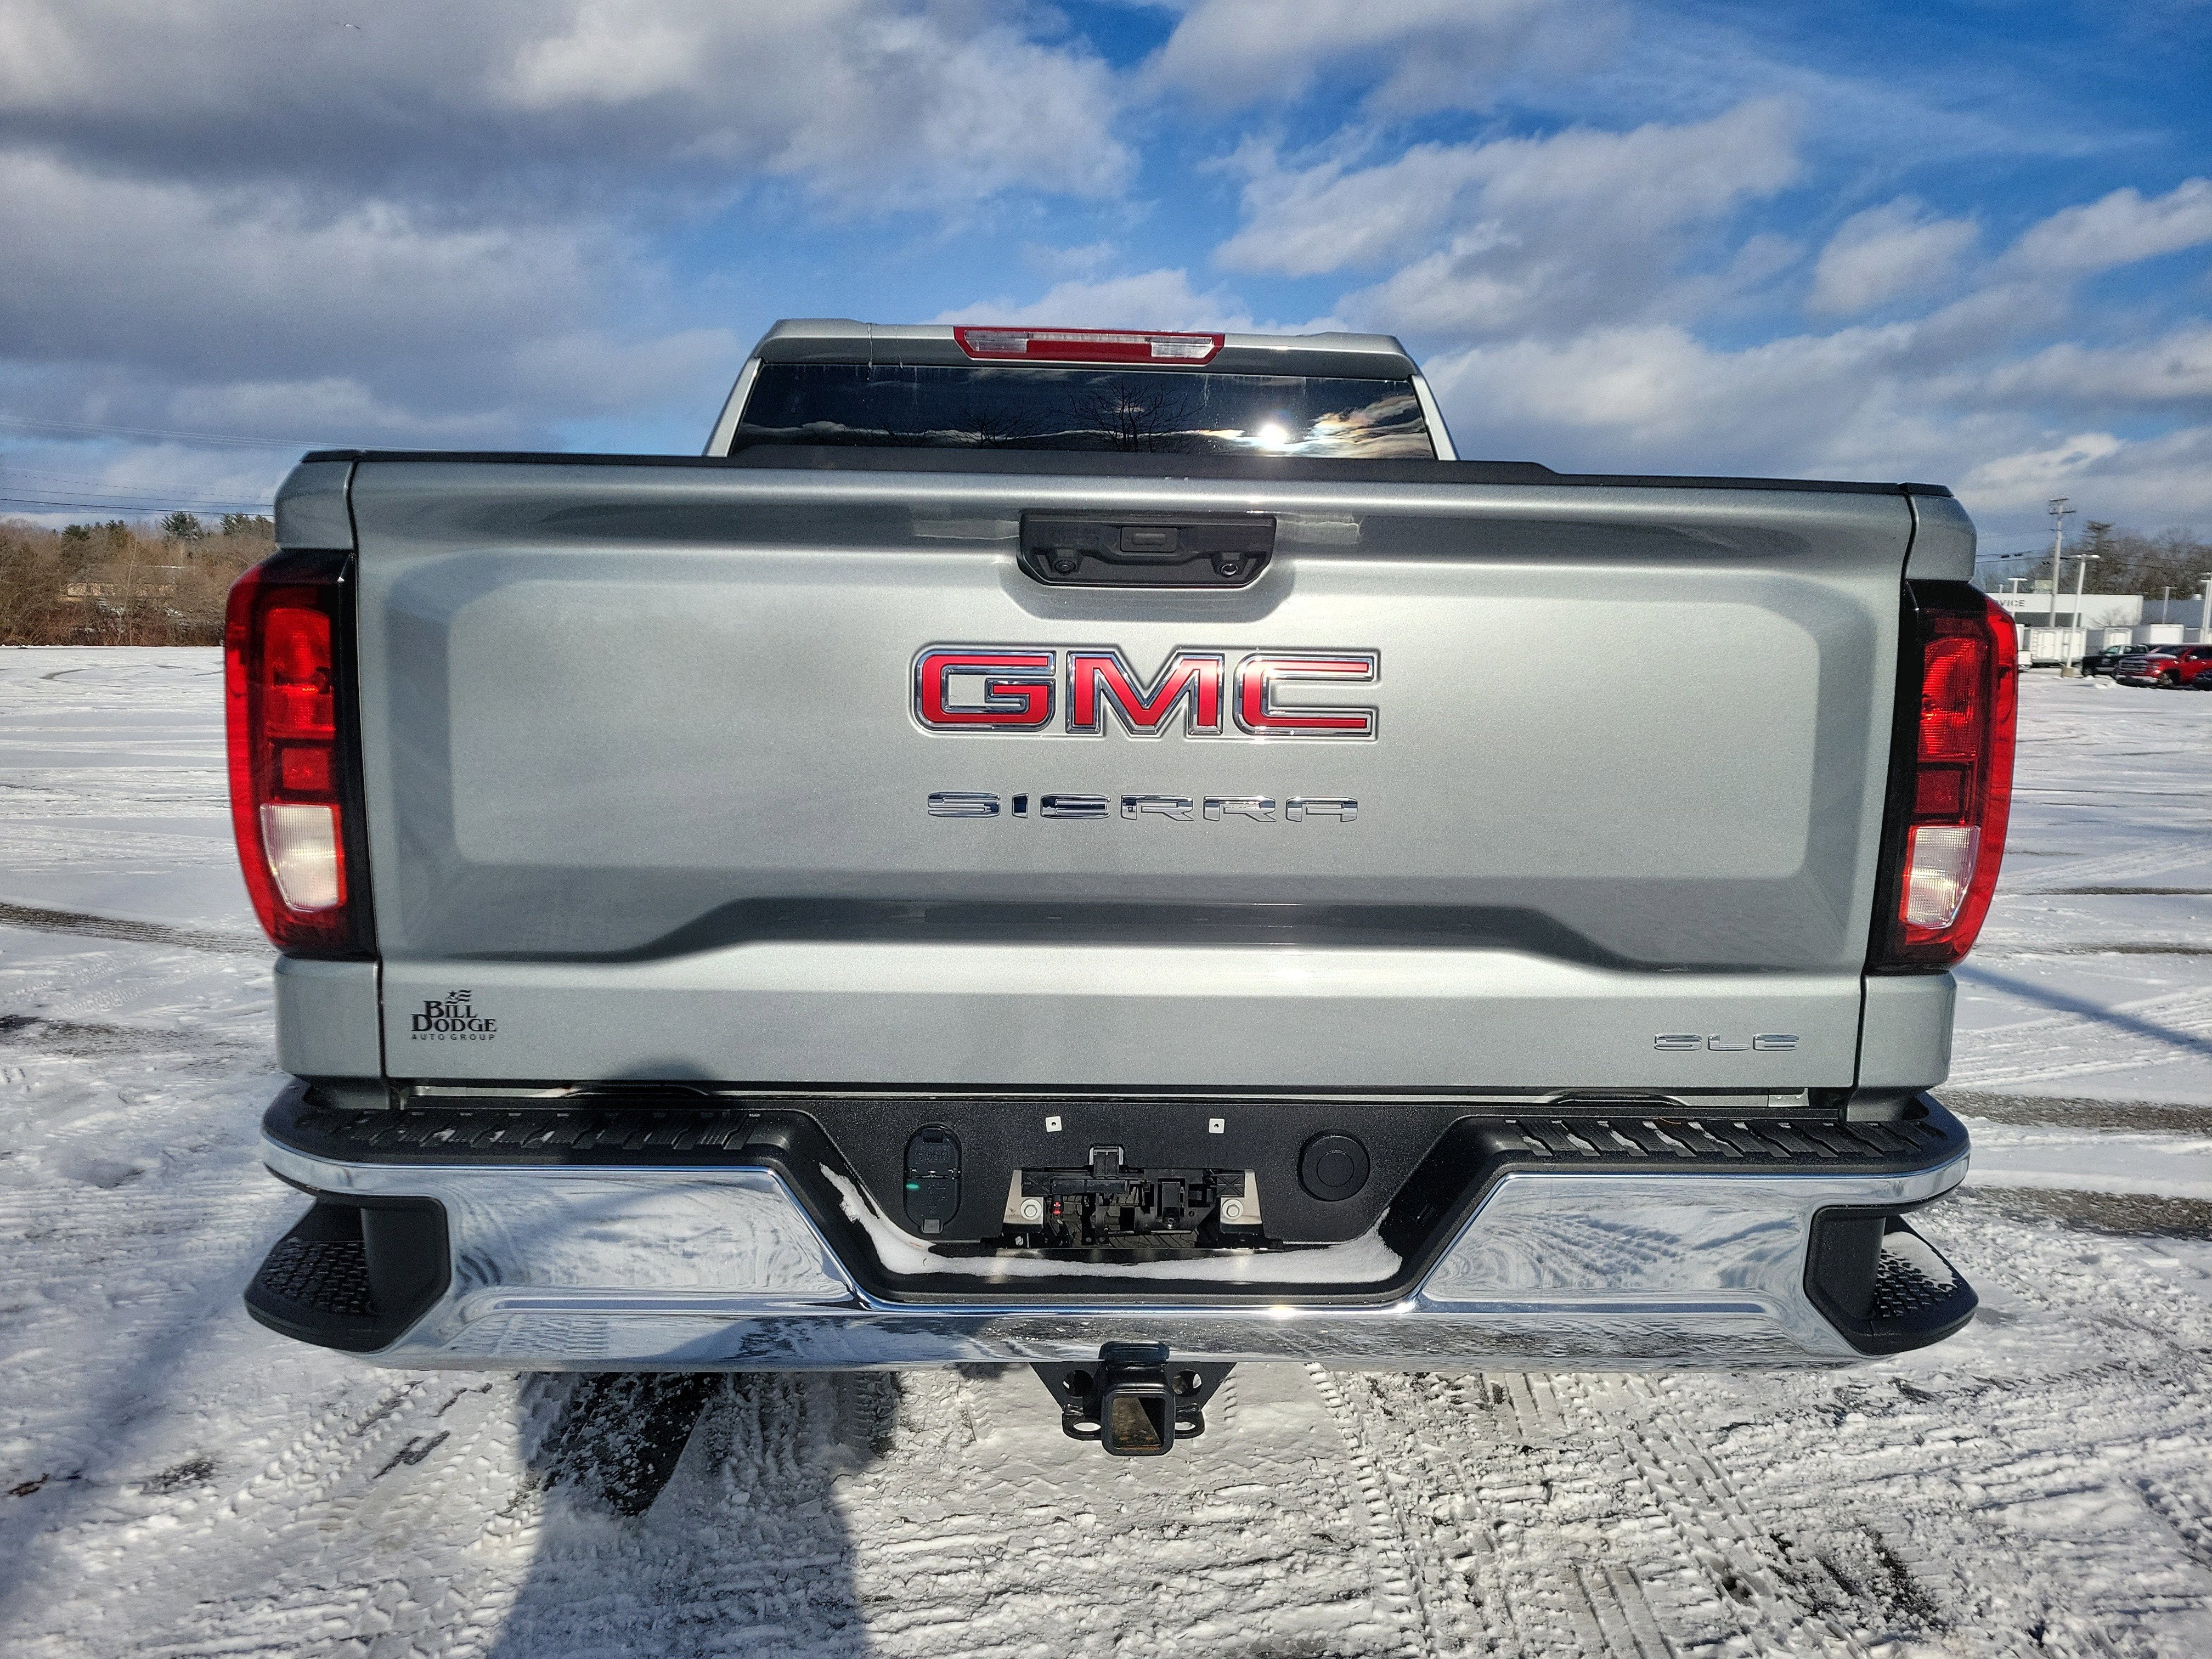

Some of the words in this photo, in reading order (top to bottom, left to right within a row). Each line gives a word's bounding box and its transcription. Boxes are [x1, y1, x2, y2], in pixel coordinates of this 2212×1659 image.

[913, 644, 1379, 740] GMC
[927, 791, 1358, 822] SIERRA
[423, 1001, 478, 1018] BILL
[410, 1014, 496, 1032] DODGE
[1654, 1033, 1799, 1051] SLE
